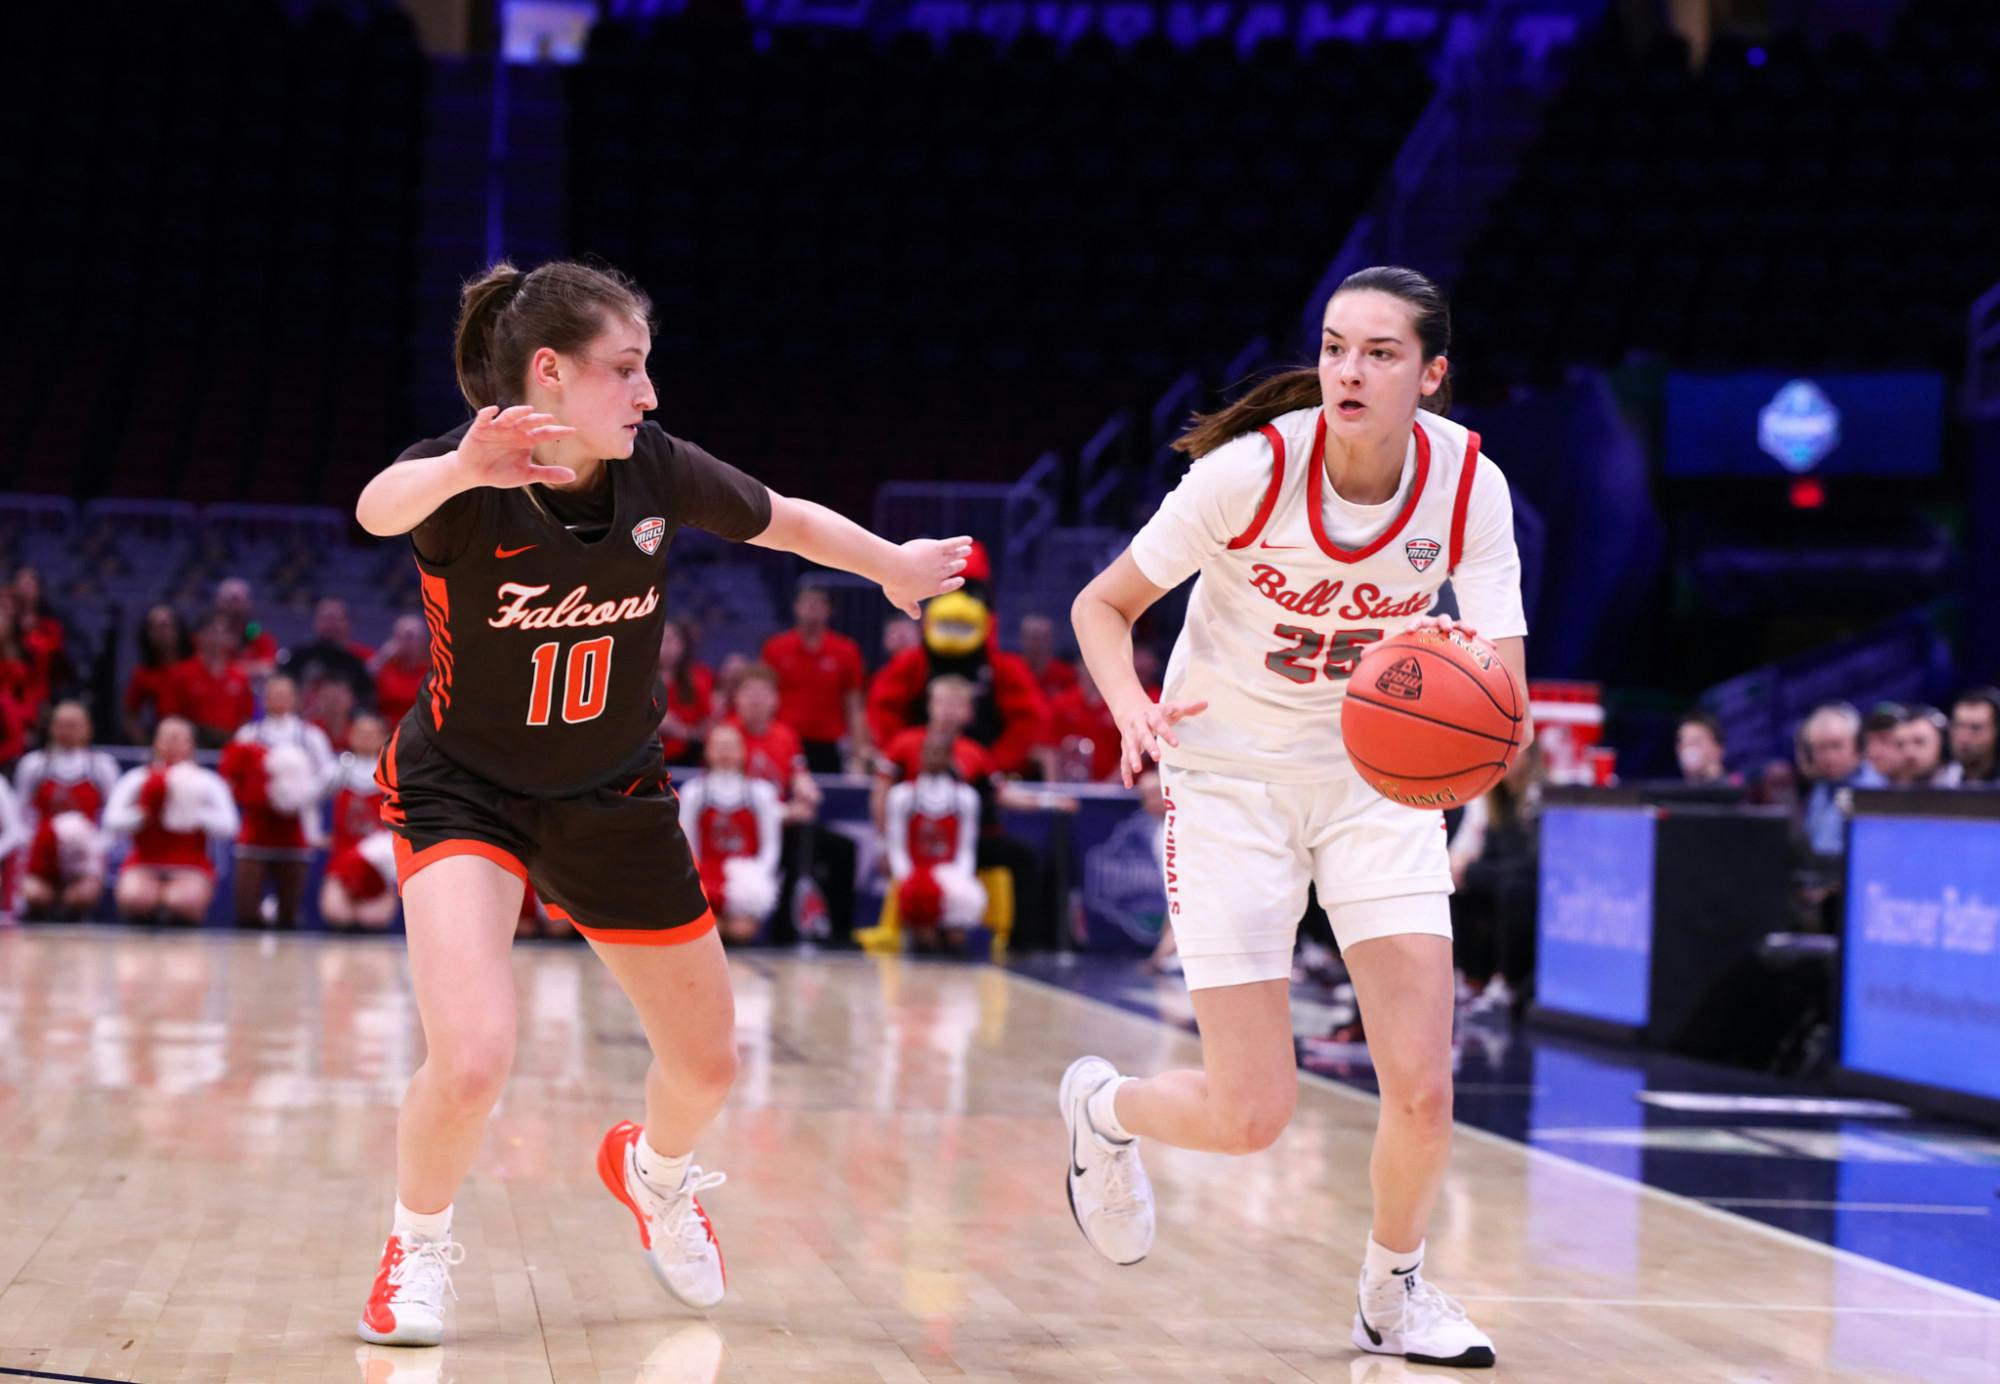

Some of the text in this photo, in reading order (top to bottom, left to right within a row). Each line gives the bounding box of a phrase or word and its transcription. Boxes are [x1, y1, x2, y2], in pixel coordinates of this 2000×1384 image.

[1407, 549, 1441, 560] MAC
[488, 582, 659, 630] Falcons
[1248, 563, 1432, 620] Ball State
[526, 635, 614, 726] 10
[1264, 623, 1385, 685] 25
